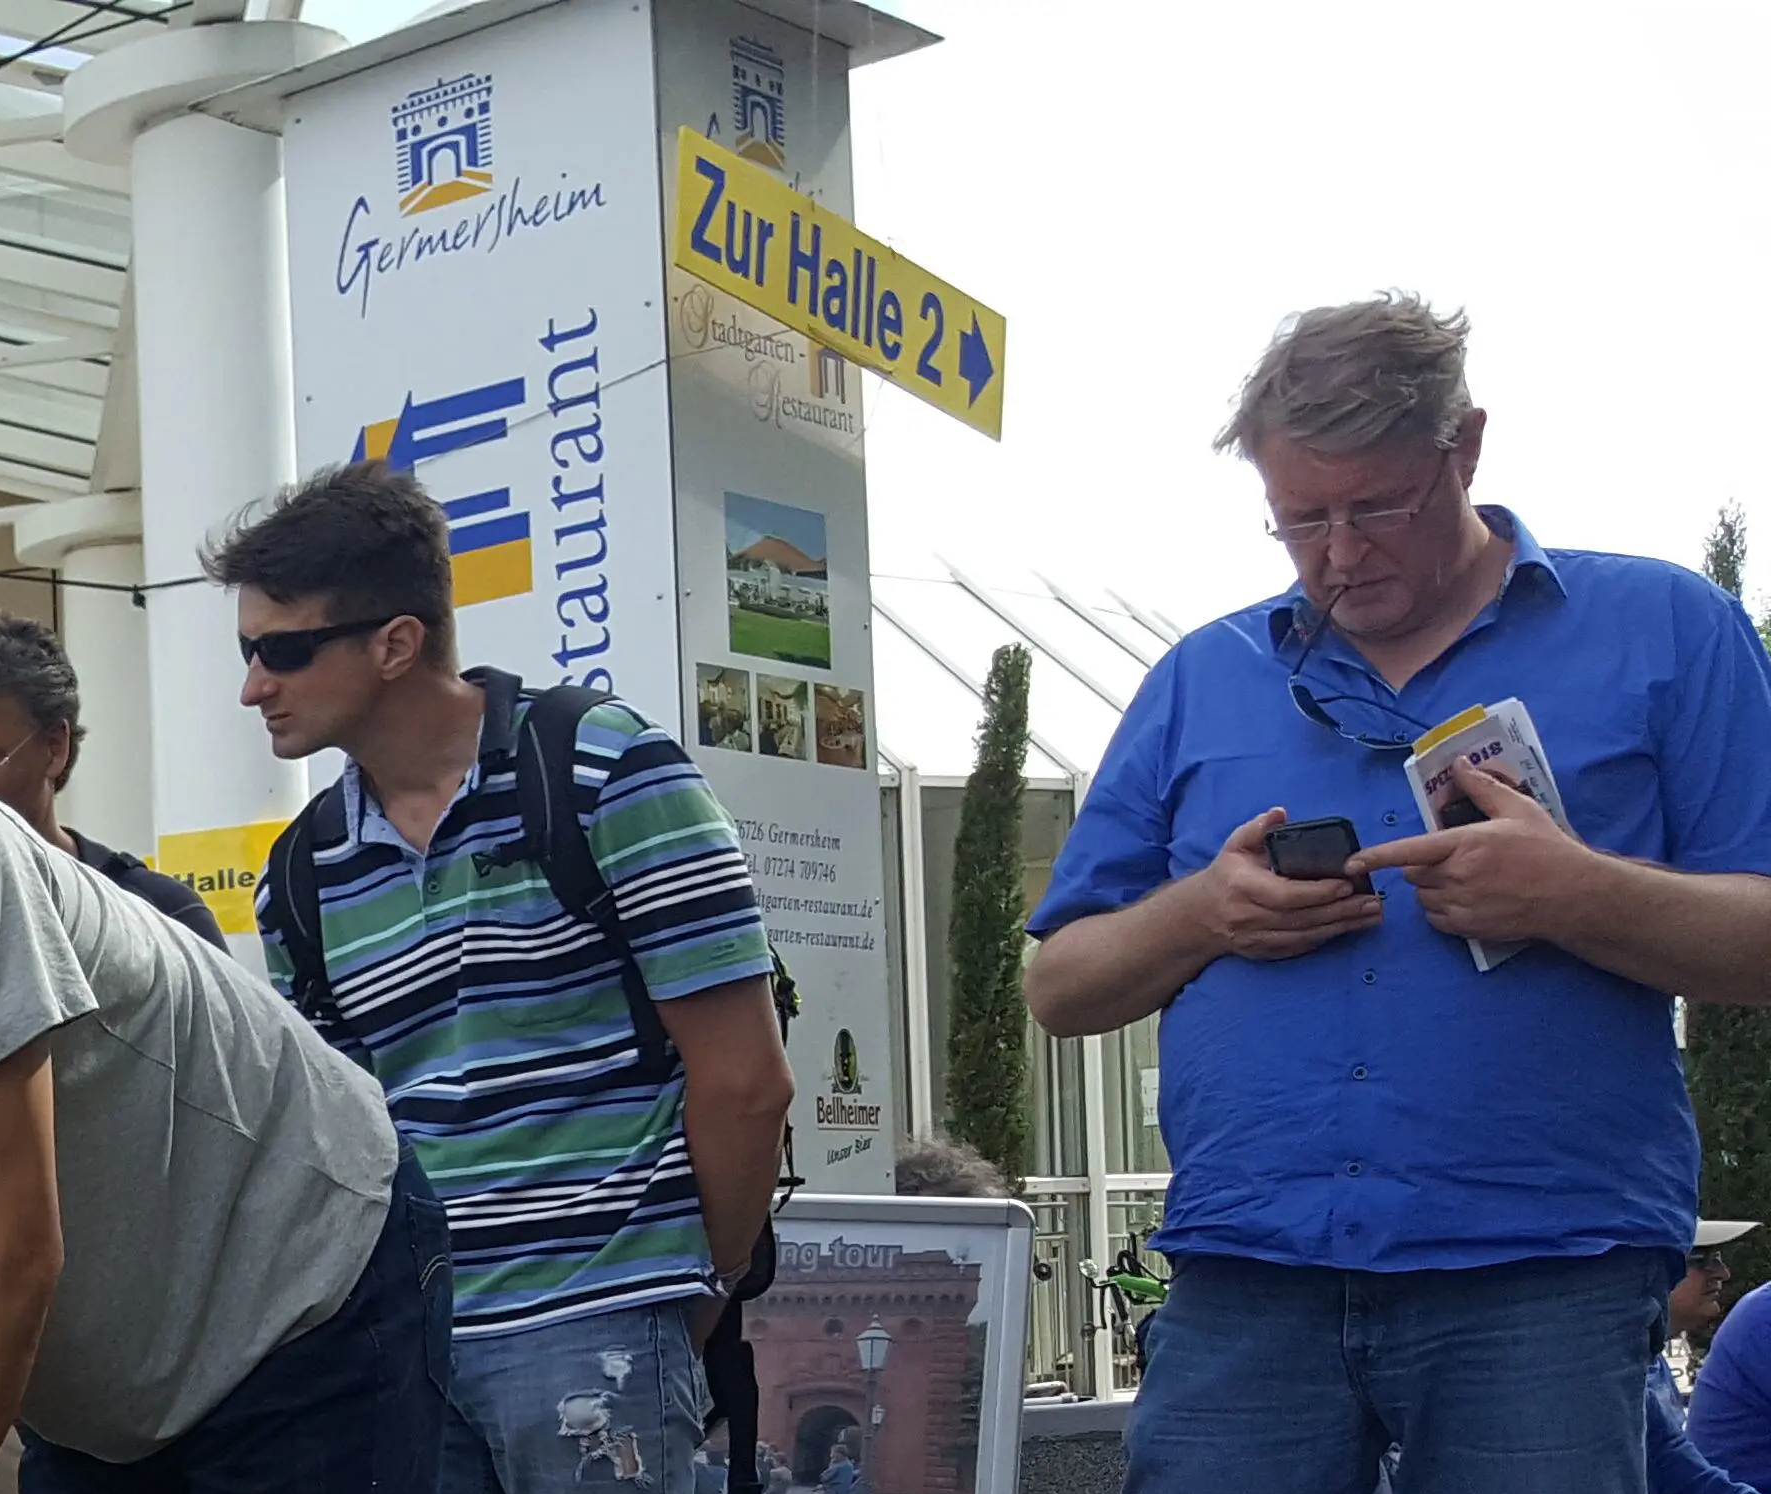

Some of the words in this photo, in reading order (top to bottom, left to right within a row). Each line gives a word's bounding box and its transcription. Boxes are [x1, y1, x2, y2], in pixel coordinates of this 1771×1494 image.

[336, 172, 607, 319] Germersheim
[690, 155, 775, 288] Zur
[787, 209, 904, 362] Halle
[916, 291, 945, 388] 2
[1469, 741, 1504, 767] 018
[768, 822, 842, 852] Germersheim
[764, 856, 796, 879] 07274
[799, 860, 837, 884] 709746
[816, 1096, 881, 1126] Bellheimer
[829, 1234, 903, 1270] tour
